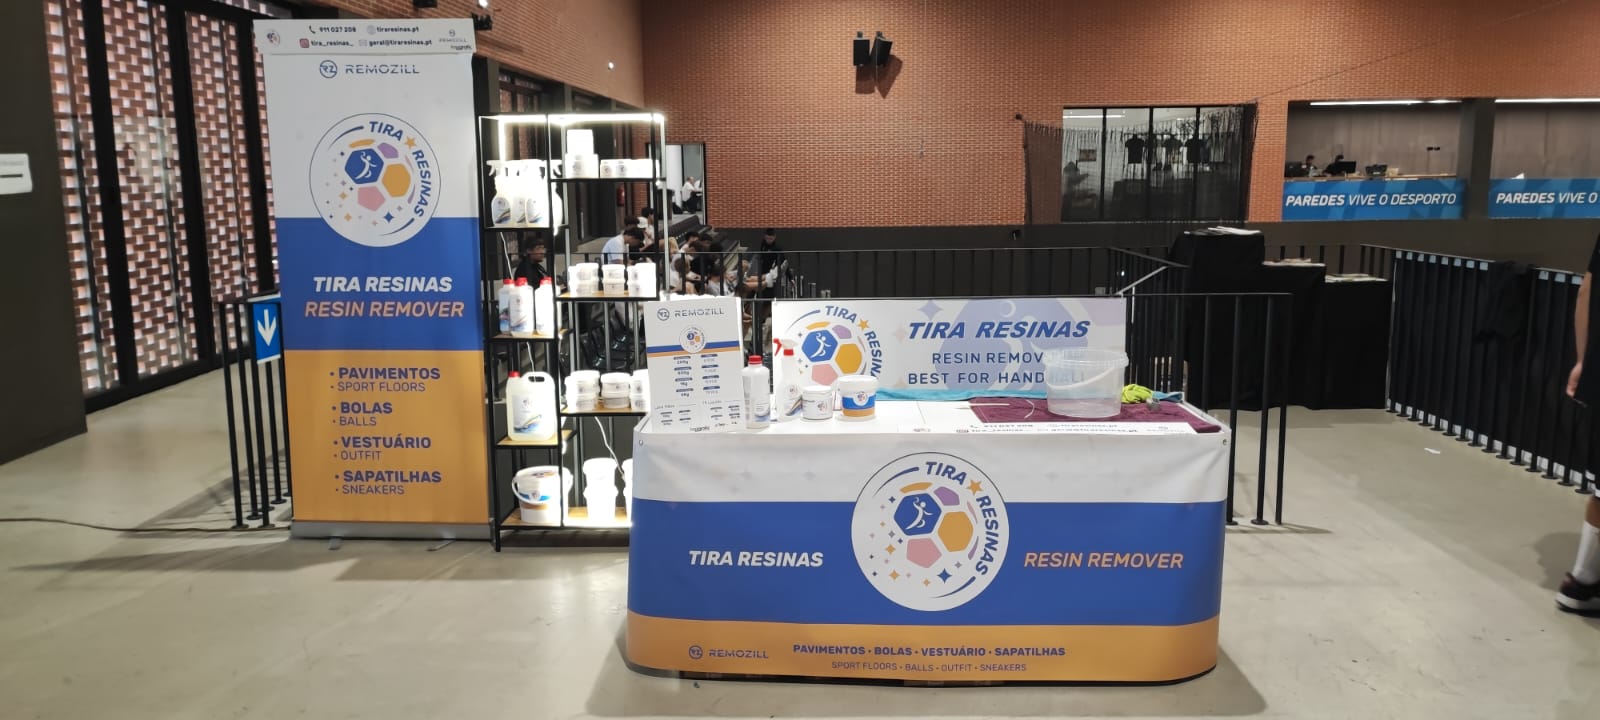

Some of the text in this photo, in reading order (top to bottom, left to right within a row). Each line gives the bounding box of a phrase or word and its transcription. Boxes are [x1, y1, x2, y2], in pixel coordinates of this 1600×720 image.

[376, 26, 420, 34] tiraresinas.pt
[369, 39, 432, 47] geral@tiraresinas.pt
[345, 64, 420, 74] REMOZILL
[369, 121, 404, 141] TIRA
[412, 149, 432, 218] RESINAS
[1285, 193, 1457, 206] PAREDES VIVE O DESPORTO
[1496, 192, 1598, 204] PAREDES VIVE O
[313, 276, 453, 293] TIRA RESINAS
[304, 301, 465, 317] RESIN REMOVER
[674, 307, 724, 318] REMOZILL
[825, 305, 857, 323] TIRA
[908, 320, 1091, 339] TIRA RESINAS
[932, 351, 1044, 364] RESIN REMOV
[338, 367, 441, 380] PAVIMENTOS
[908, 372, 949, 385] BEST
[957, 372, 989, 384] FOR
[337, 381, 426, 392] SPORT FLOORS
[340, 402, 393, 414] BOLAS
[339, 416, 377, 426] BALLS
[341, 433, 432, 449] VESTUÁRIO
[340, 450, 382, 461] OUTFIT
[343, 470, 442, 483] SAPATILHAS
[925, 461, 967, 486] TIRA
[342, 484, 405, 495] SNEAKERS
[976, 495, 999, 576] RESINAS
[689, 550, 824, 567] TIRA RESINAS
[1024, 552, 1184, 569] RESIN REMOVER
[708, 648, 769, 659] REMOZILL
[793, 644, 1066, 657] PAVIMENTOS BOLAS VESTUÁRIO SAPATILHAS
[831, 661, 1027, 672] SPORT FLOORS BALLS OUTFIT SNEAKERS
